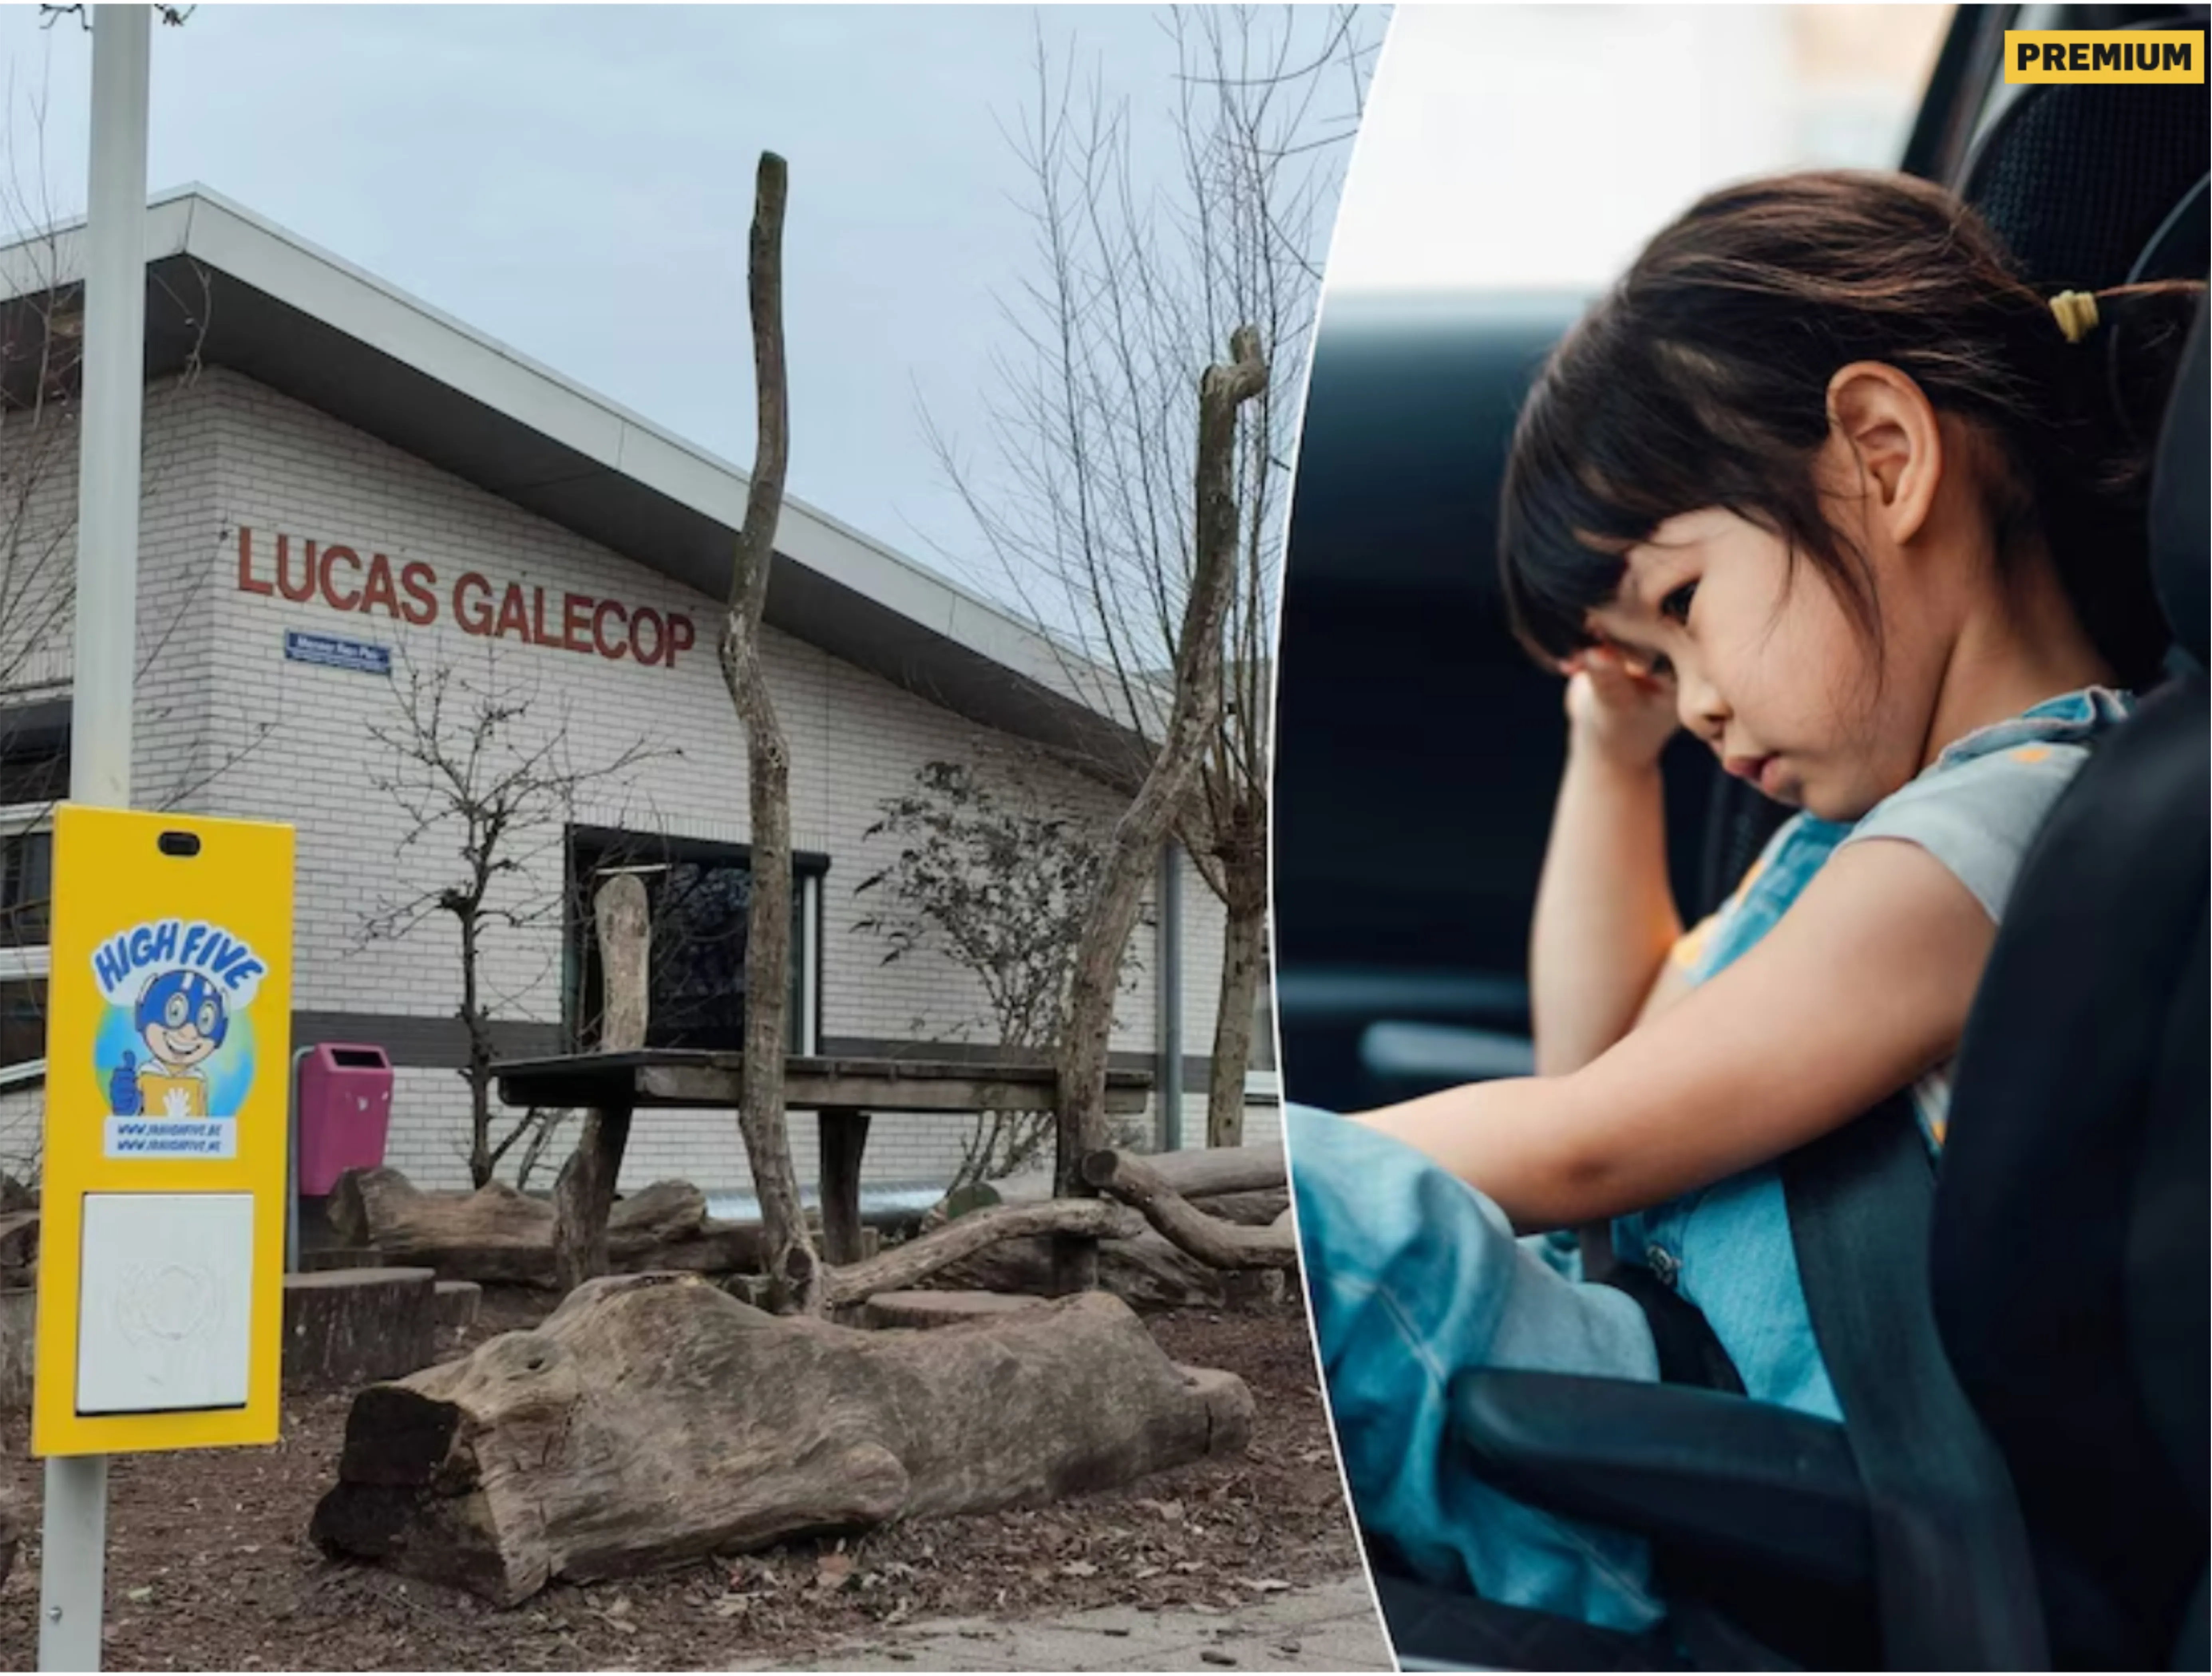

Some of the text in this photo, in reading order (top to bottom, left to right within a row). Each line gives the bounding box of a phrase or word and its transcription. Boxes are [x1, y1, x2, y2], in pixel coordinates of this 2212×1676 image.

[239, 527, 695, 668] LUCAS GALECOP
[95, 921, 264, 992] HIGH FIVE
